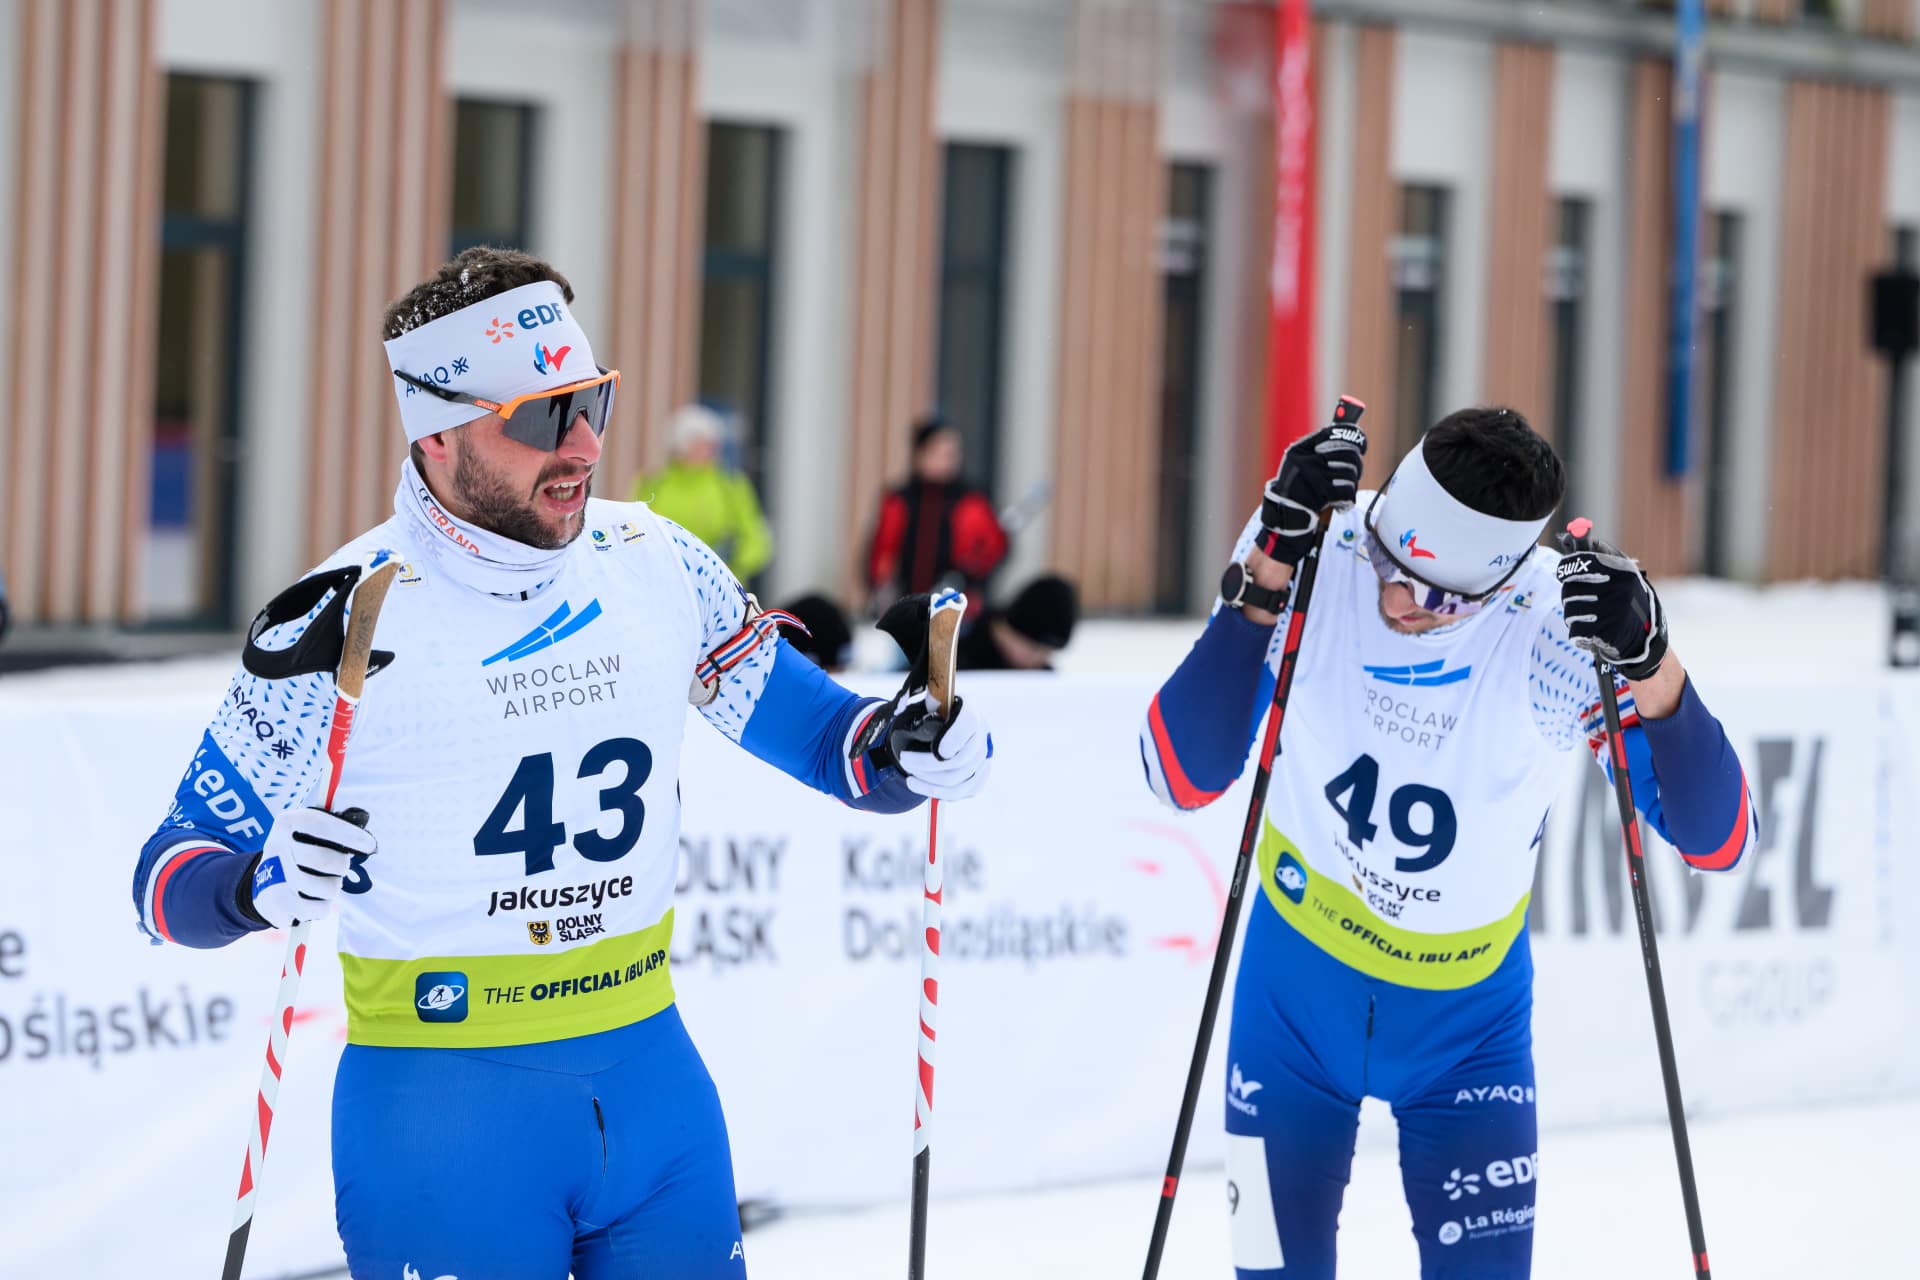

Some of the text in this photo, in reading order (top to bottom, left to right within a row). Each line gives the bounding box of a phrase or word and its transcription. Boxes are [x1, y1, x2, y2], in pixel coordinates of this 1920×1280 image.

[486, 654, 621, 696] WROCLAW
[503, 680, 618, 719] AIRPORT
[1363, 684, 1458, 732] ROCLAW
[473, 737, 653, 877] 43
[1325, 753, 1458, 874] 49
[675, 834, 788, 895] OLNY
[556, 913, 603, 931] DOLNY
[1312, 896, 1341, 923] THE
[1340, 918, 1414, 962] OFFICIAL
[1418, 952, 1453, 963] IBU
[484, 949, 666, 1005] THE OFFICIAL IBU APP
[1454, 1084, 1524, 1105] AYAQ
